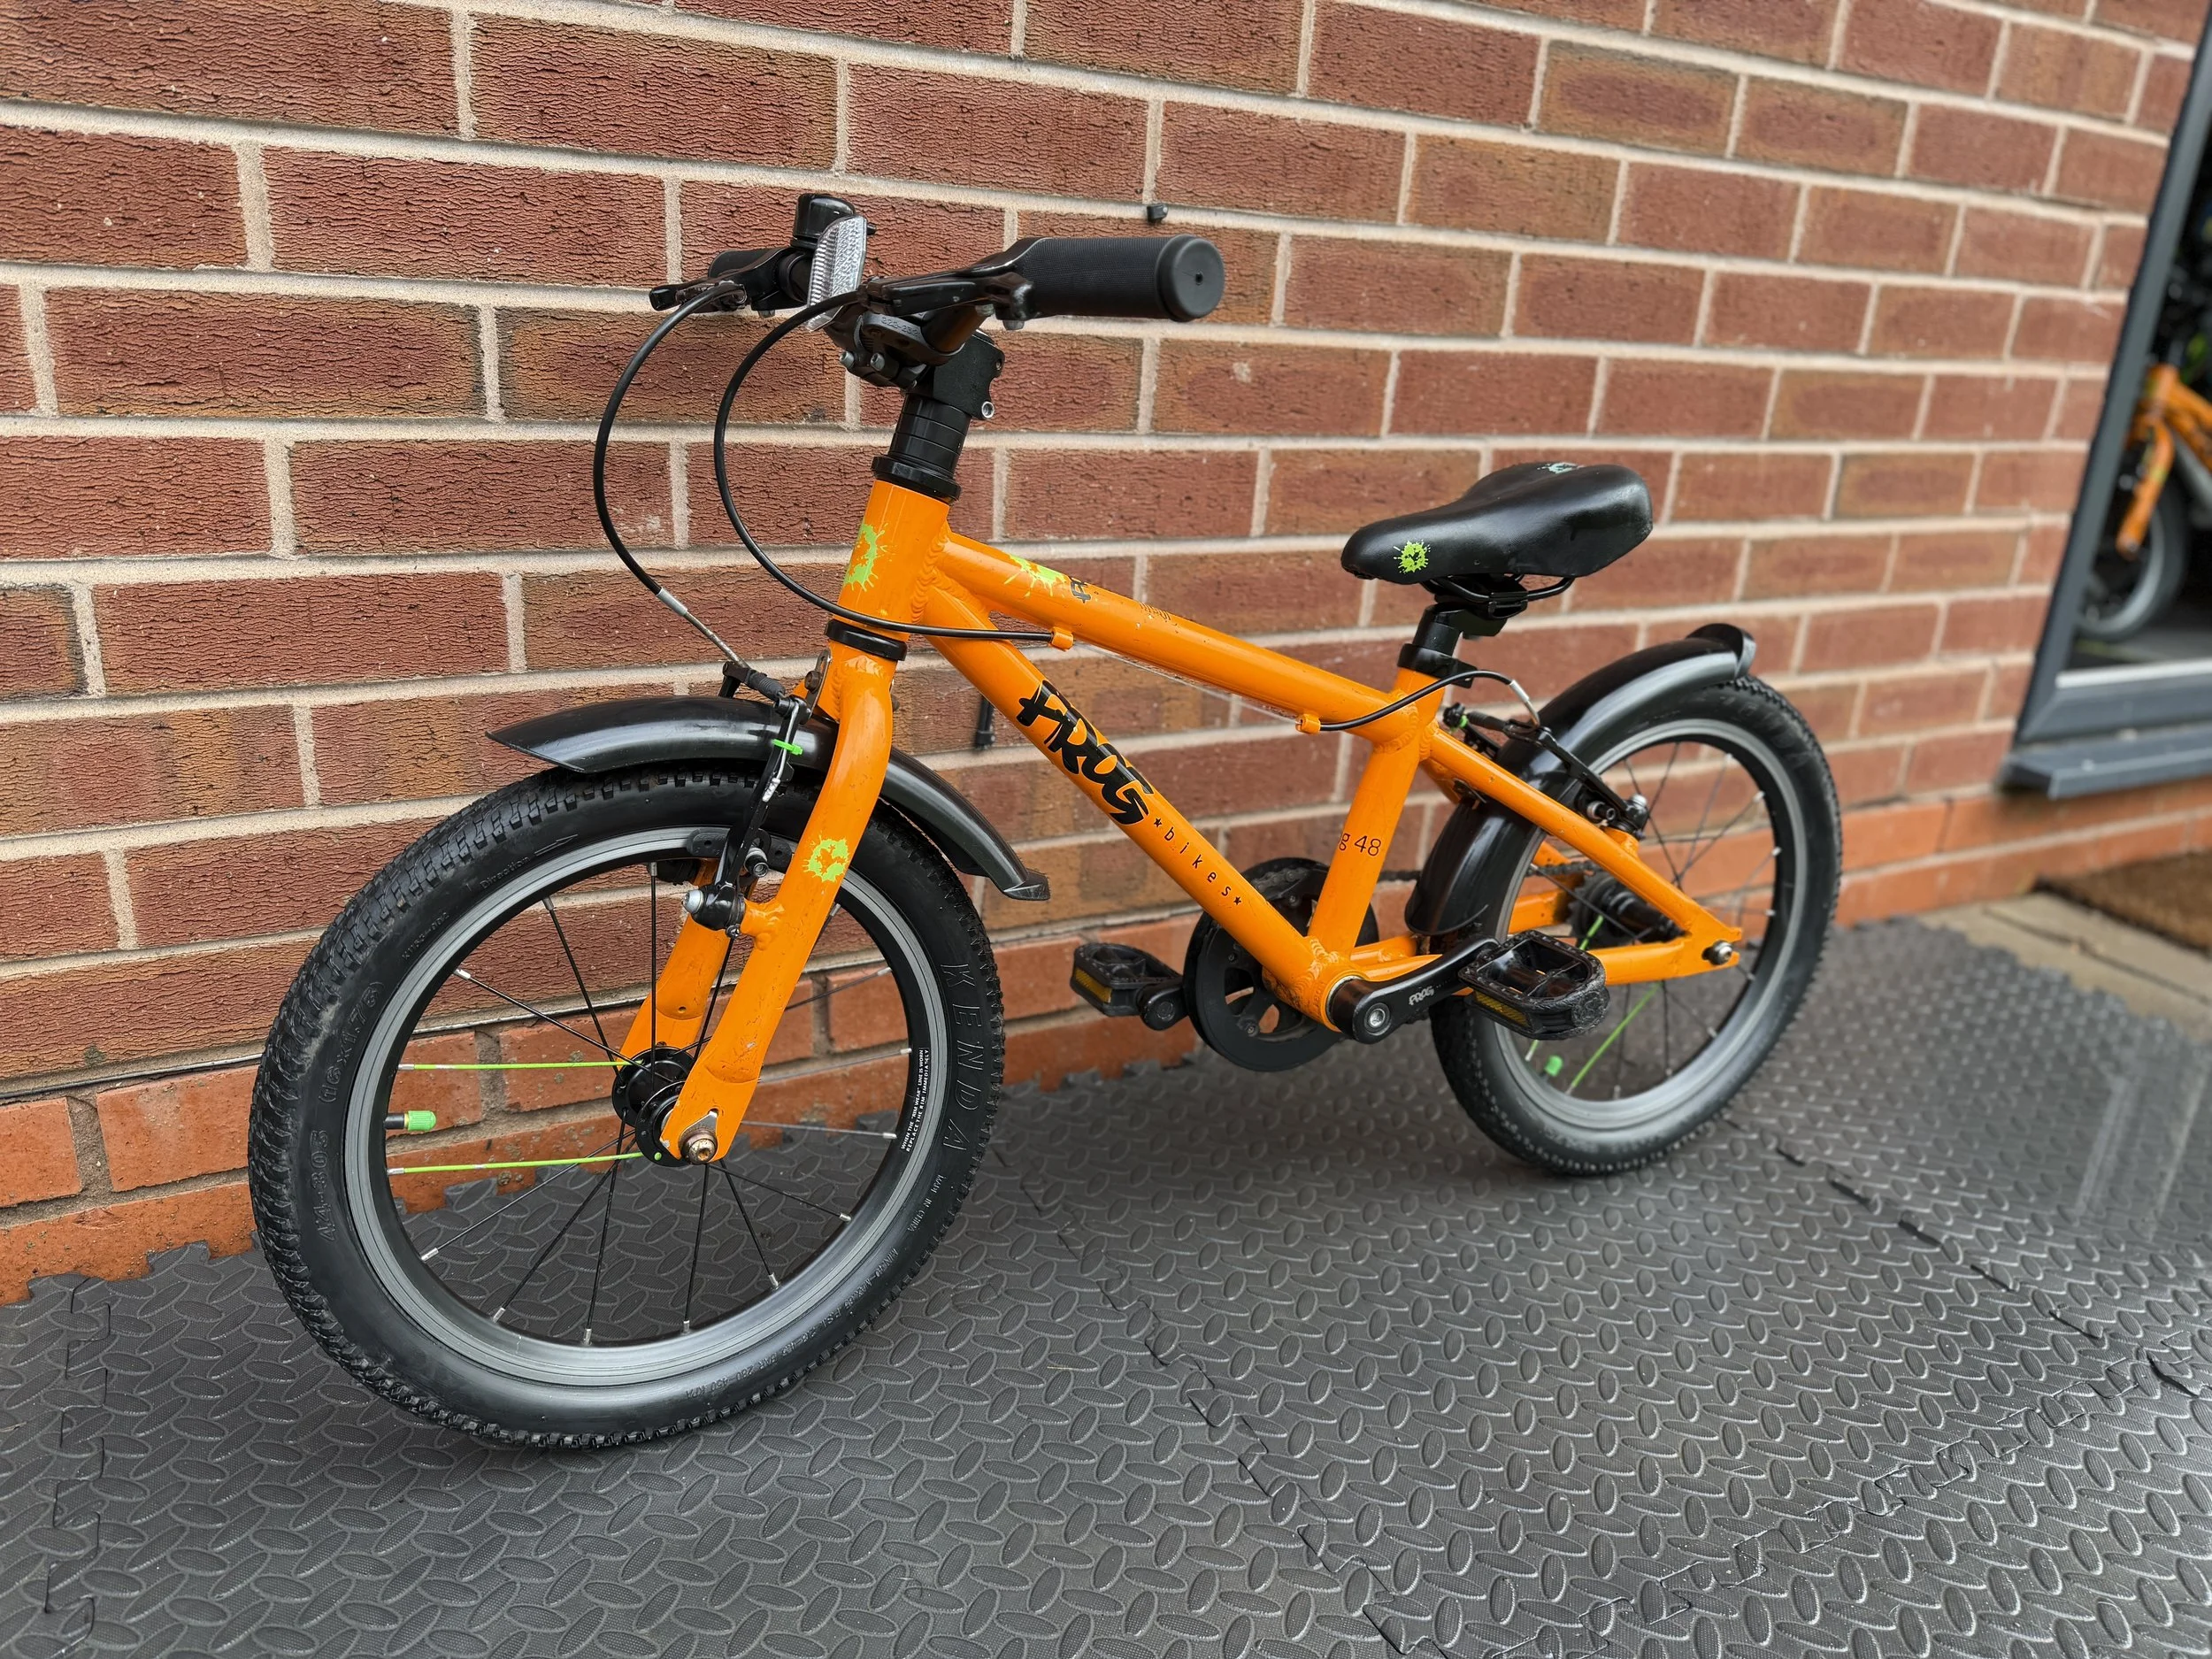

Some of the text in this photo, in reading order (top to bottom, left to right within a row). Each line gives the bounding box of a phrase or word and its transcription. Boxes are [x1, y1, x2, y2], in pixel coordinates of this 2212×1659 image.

[1354, 835, 1381, 856] 48
[479, 856, 532, 889] Direction
[1164, 827, 1231, 896] bikes
[941, 964, 985, 1151] KENDA
[901, 1129, 910, 1149] WHEN
[906, 1125, 919, 1152] REPLACE
[923, 1197, 933, 1208] IN
[907, 1210, 926, 1233] CHINA
